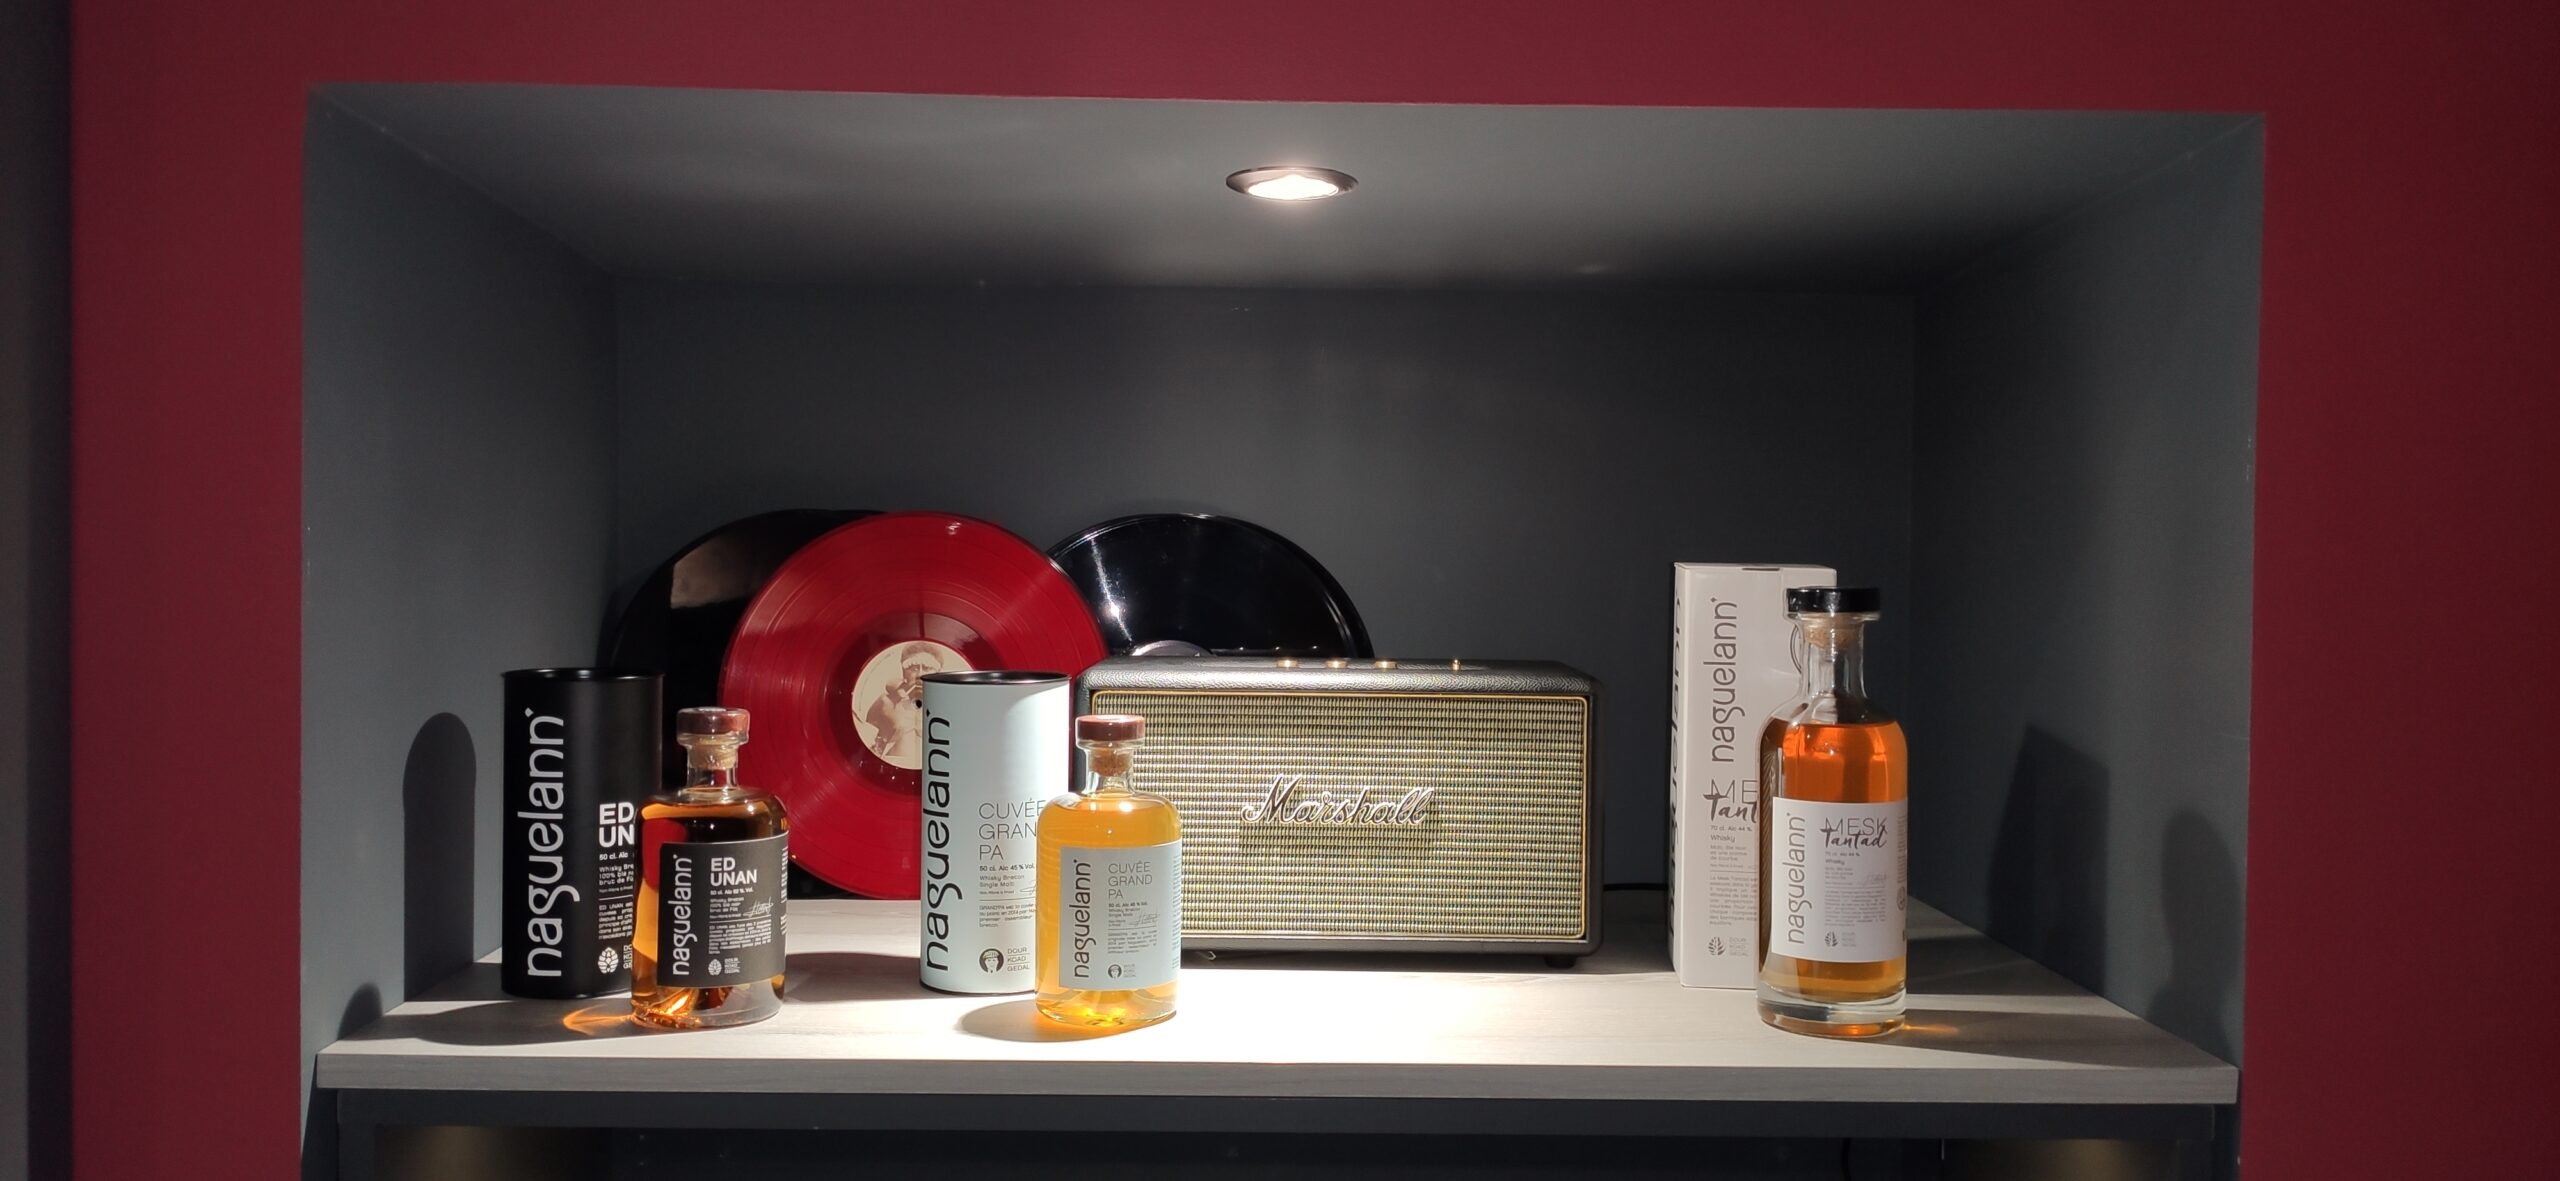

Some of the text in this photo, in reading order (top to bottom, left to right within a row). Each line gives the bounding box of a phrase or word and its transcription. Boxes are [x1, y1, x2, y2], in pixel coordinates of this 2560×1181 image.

[1703, 597, 1745, 764] naguelann
[1242, 774, 1435, 825] Marshall
[1711, 779, 1758, 804] ME
[600, 802, 634, 824] ED
[1703, 793, 1757, 823] Tant
[599, 824, 635, 848] UN
[979, 821, 1037, 840] GRAN
[1825, 817, 1888, 836] MESK
[517, 707, 580, 977] naguelann
[923, 709, 963, 972] naguelann
[979, 844, 1004, 861] PA
[711, 857, 736, 871] ED
[1108, 860, 1151, 874] CUVÉE
[710, 868, 757, 887] UNAN
[1108, 874, 1153, 887] GRAND
[1782, 812, 1812, 945] naguelann
[1108, 888, 1124, 899] PA
[668, 854, 698, 976] naguelann
[1069, 859, 1096, 979] naguelann
